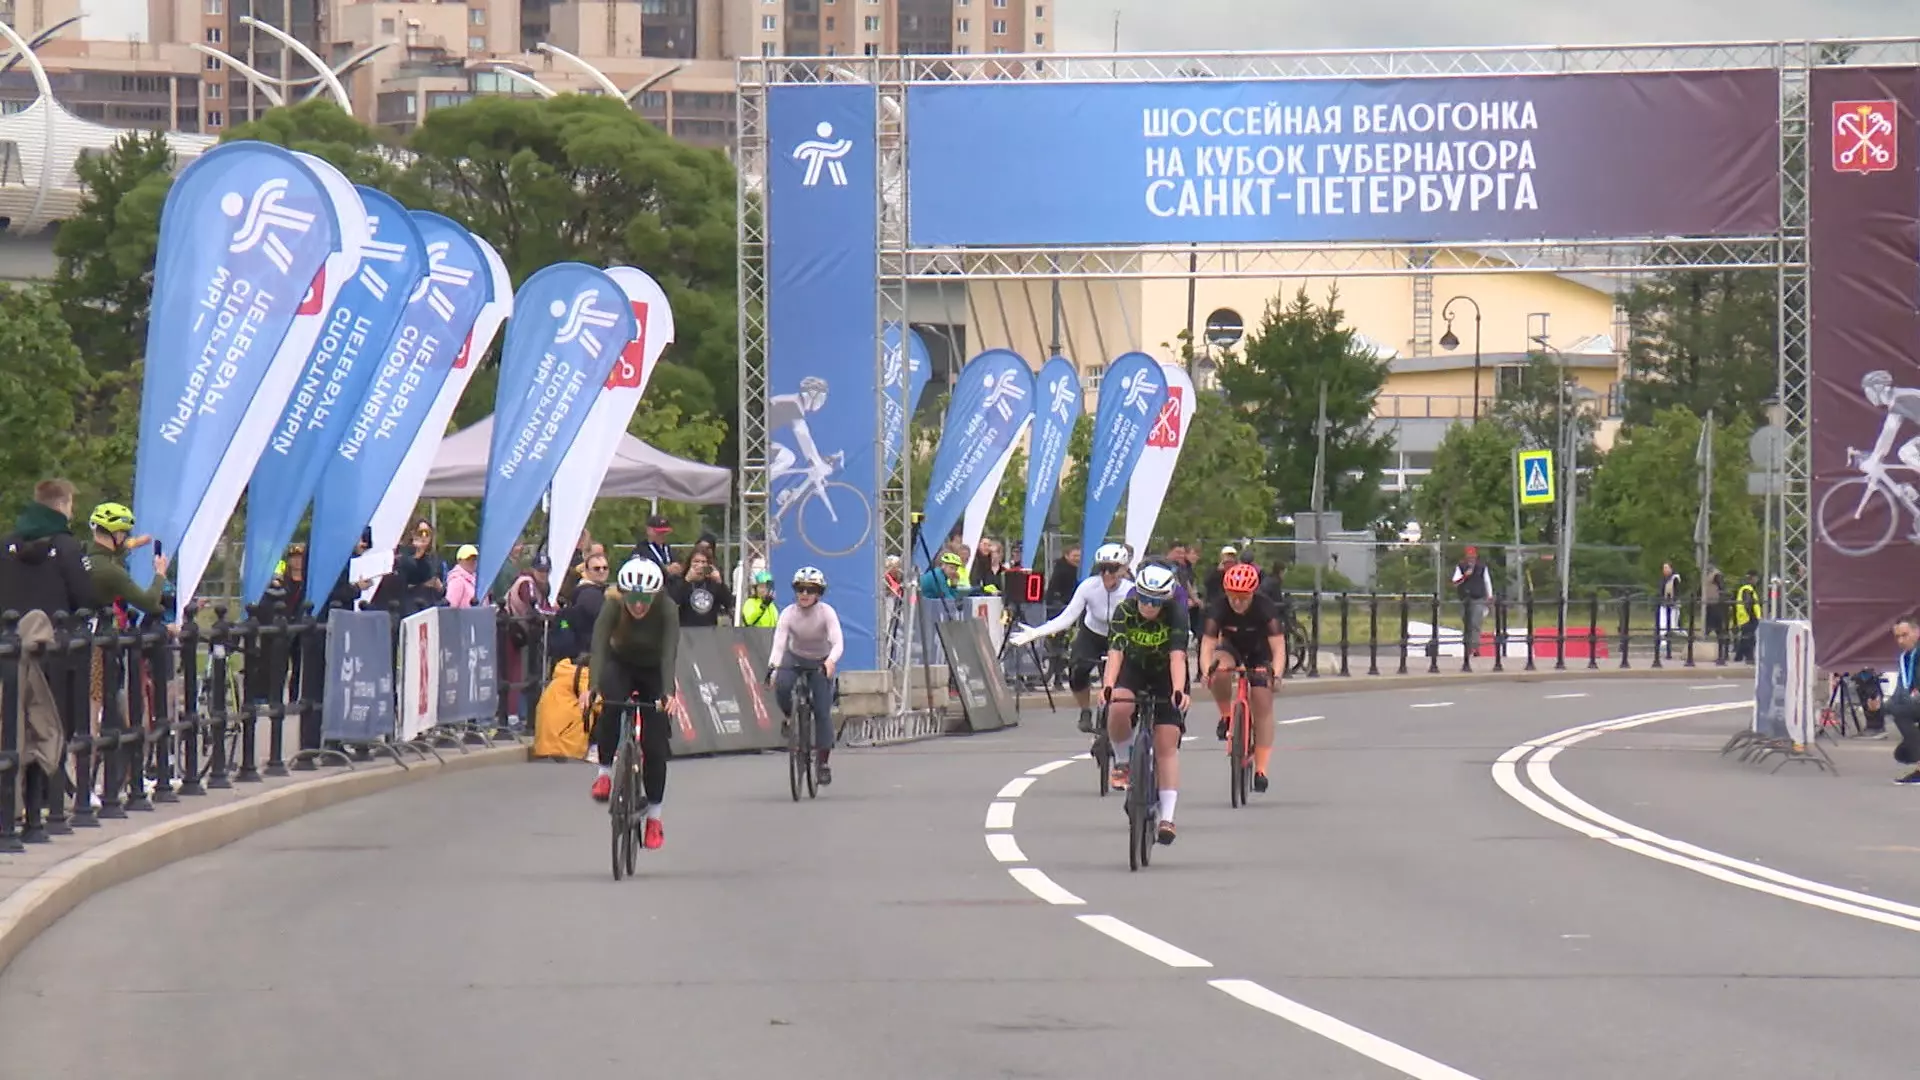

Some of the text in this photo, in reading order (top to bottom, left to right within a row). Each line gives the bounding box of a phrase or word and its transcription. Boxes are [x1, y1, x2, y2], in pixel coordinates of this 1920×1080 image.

[1143, 101, 1538, 137] ШОССЕЙНАЯ ВЕЛОГОНКА
[1146, 140, 1537, 177] НА КУБОК ГУБЕРНАТОРА
[1145, 172, 1538, 217] САНКТ-ПЕТЕРБУРГА
